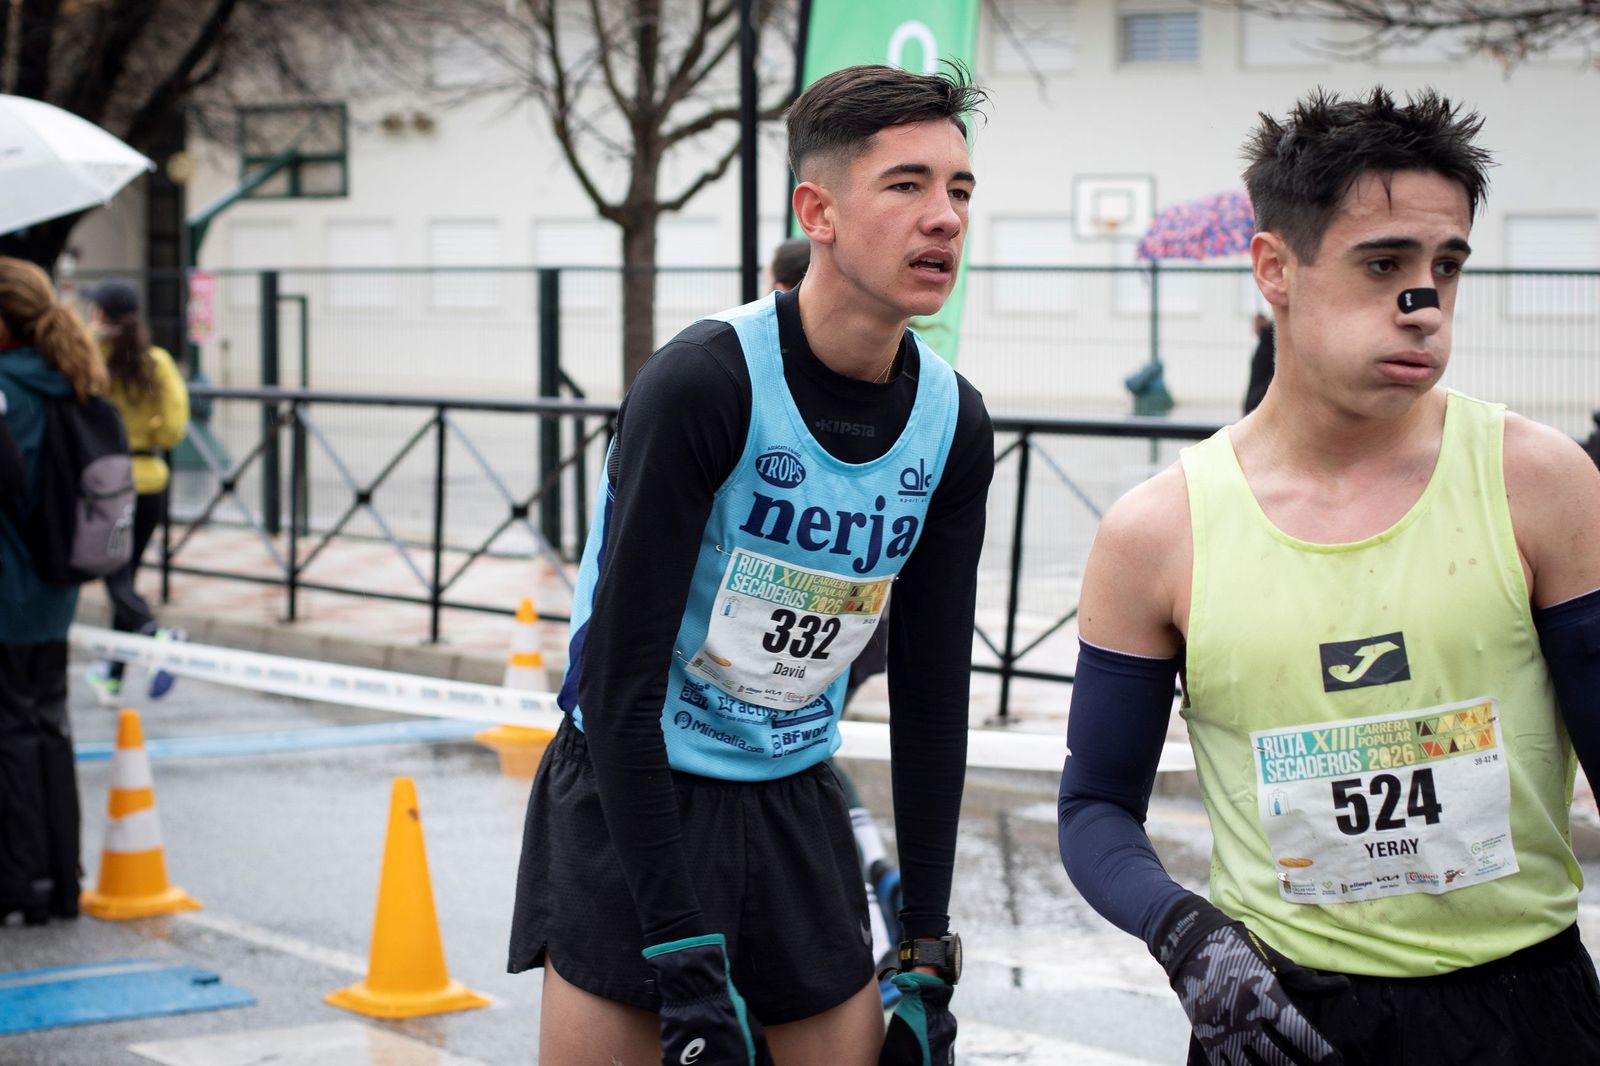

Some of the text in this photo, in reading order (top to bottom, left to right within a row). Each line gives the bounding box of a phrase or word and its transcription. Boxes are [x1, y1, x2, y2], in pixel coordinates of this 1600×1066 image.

[758, 455, 803, 483] TROPS
[739, 491, 919, 574] nerja
[737, 555, 814, 592] RUTA XIII
[813, 576, 850, 591] CARRERA
[731, 573, 808, 610] SECADEROS
[808, 594, 843, 615] 2026
[810, 584, 848, 598] POPULAR
[762, 608, 841, 660] 332
[773, 662, 807, 679] David
[1356, 719, 1410, 737] CARRERA
[1357, 729, 1411, 749] POPULAR
[1262, 727, 1355, 760] RUTA XIII
[1367, 743, 1416, 771] 2026
[1265, 750, 1362, 783] SECADEROS
[1331, 767, 1442, 835] 524
[1364, 838, 1419, 859] YERAY
